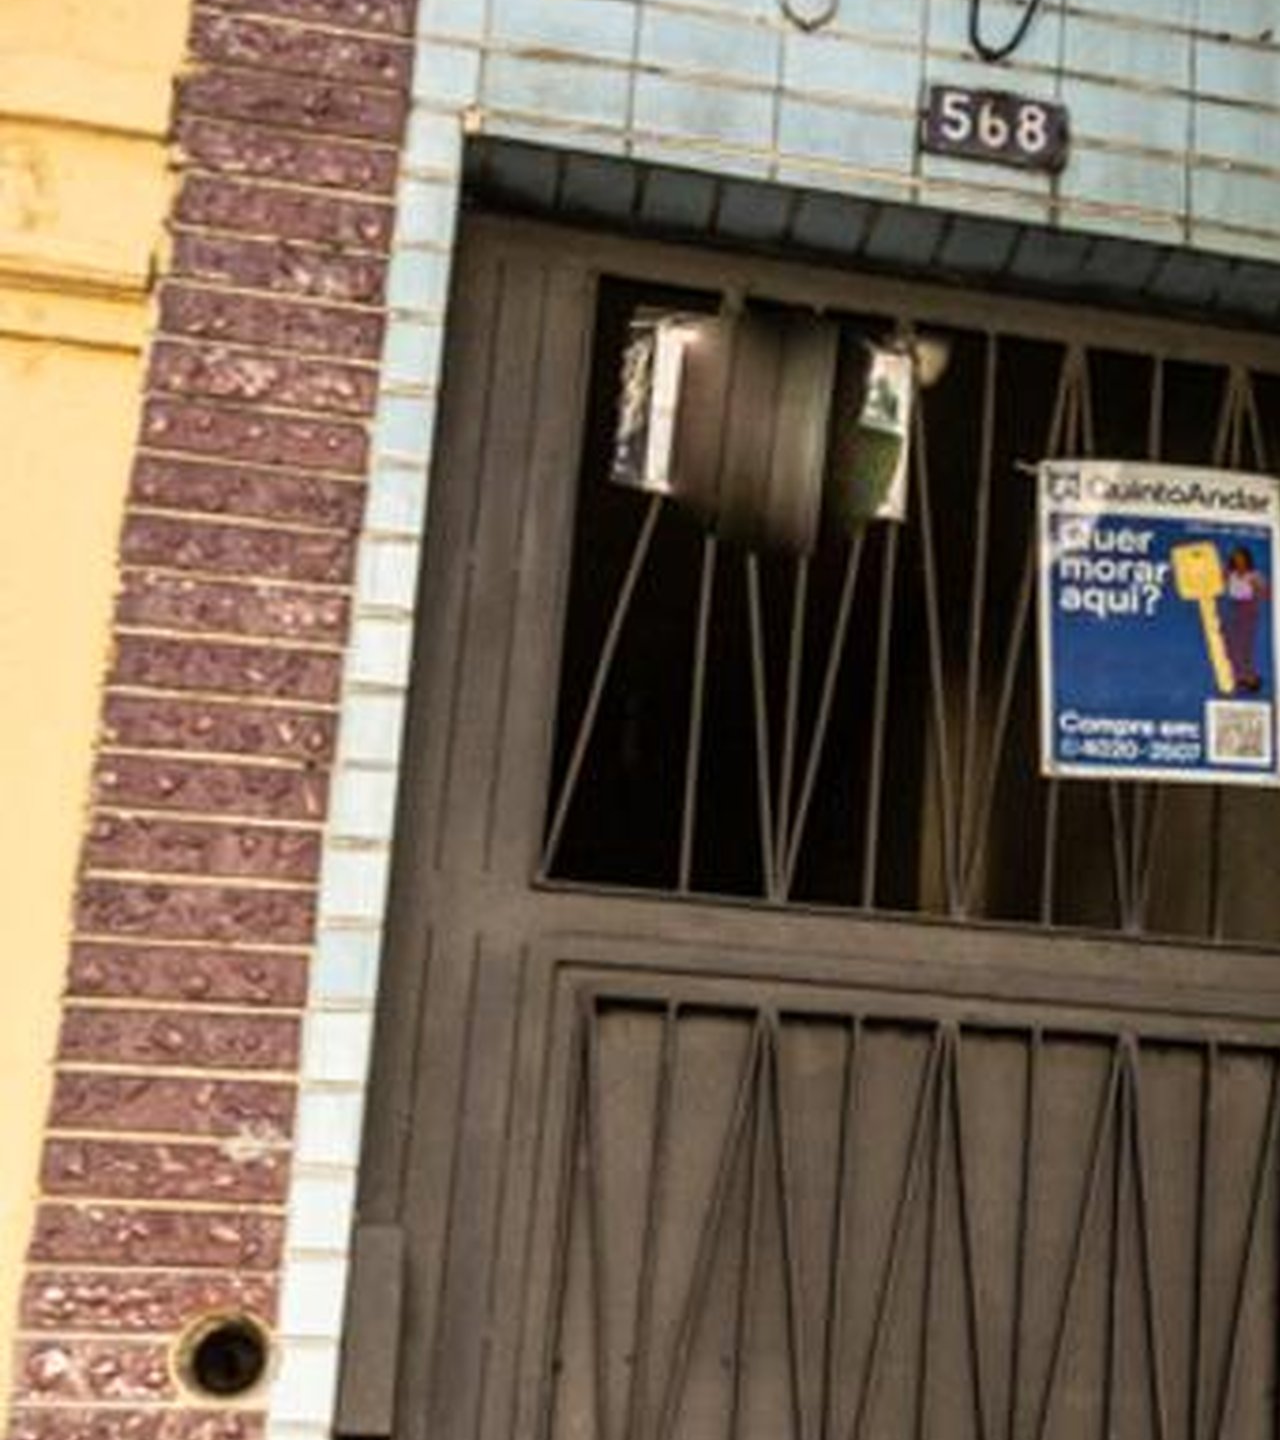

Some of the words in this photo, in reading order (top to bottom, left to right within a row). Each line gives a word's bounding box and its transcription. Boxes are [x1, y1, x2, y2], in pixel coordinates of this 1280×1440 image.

[941, 92, 1047, 153] 568
[1060, 518, 1155, 553] Quer
[1060, 556, 1169, 585] morar
[1059, 584, 1162, 619] aqui?
